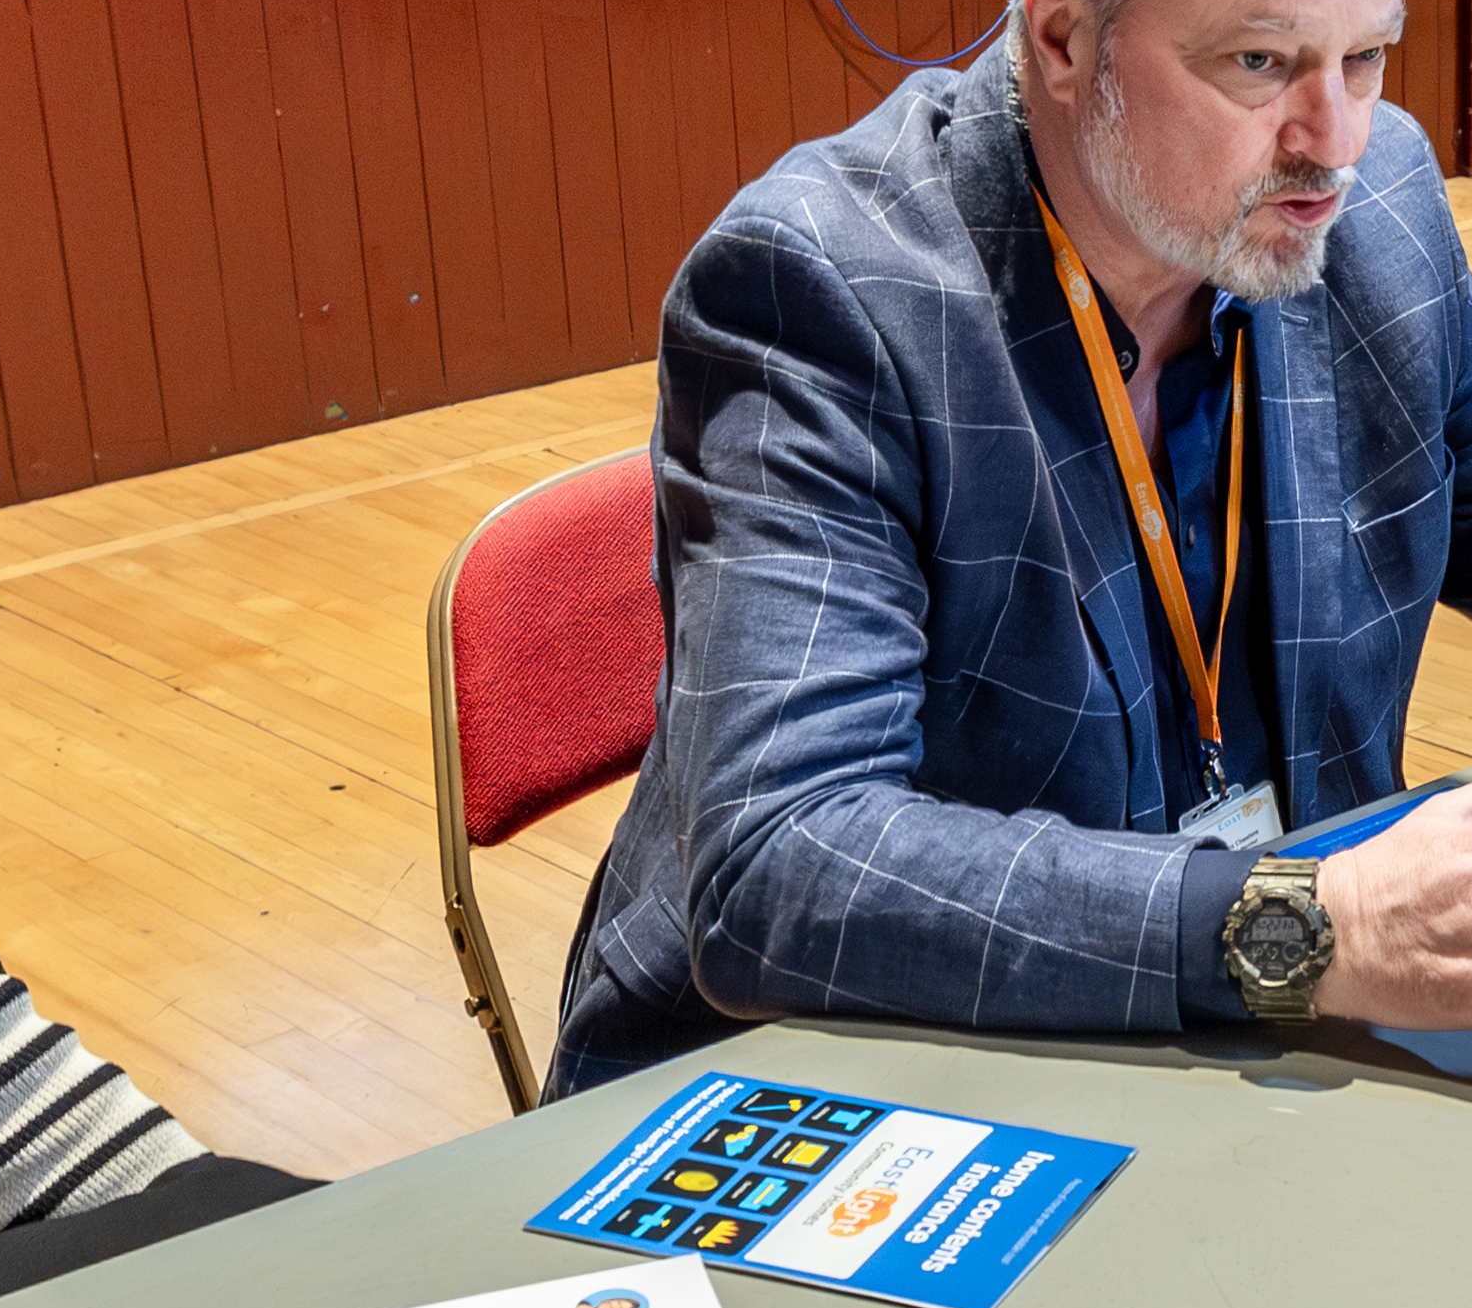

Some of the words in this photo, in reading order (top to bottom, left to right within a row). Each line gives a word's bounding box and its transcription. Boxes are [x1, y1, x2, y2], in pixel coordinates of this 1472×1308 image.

[826, 1147, 935, 1235] Eastlight
[833, 1142, 895, 1193] Community
[989, 1150, 1056, 1199] home
[802, 1194, 838, 1227] Homes
[903, 1162, 990, 1245] insurance
[920, 1198, 1004, 1274] contents
